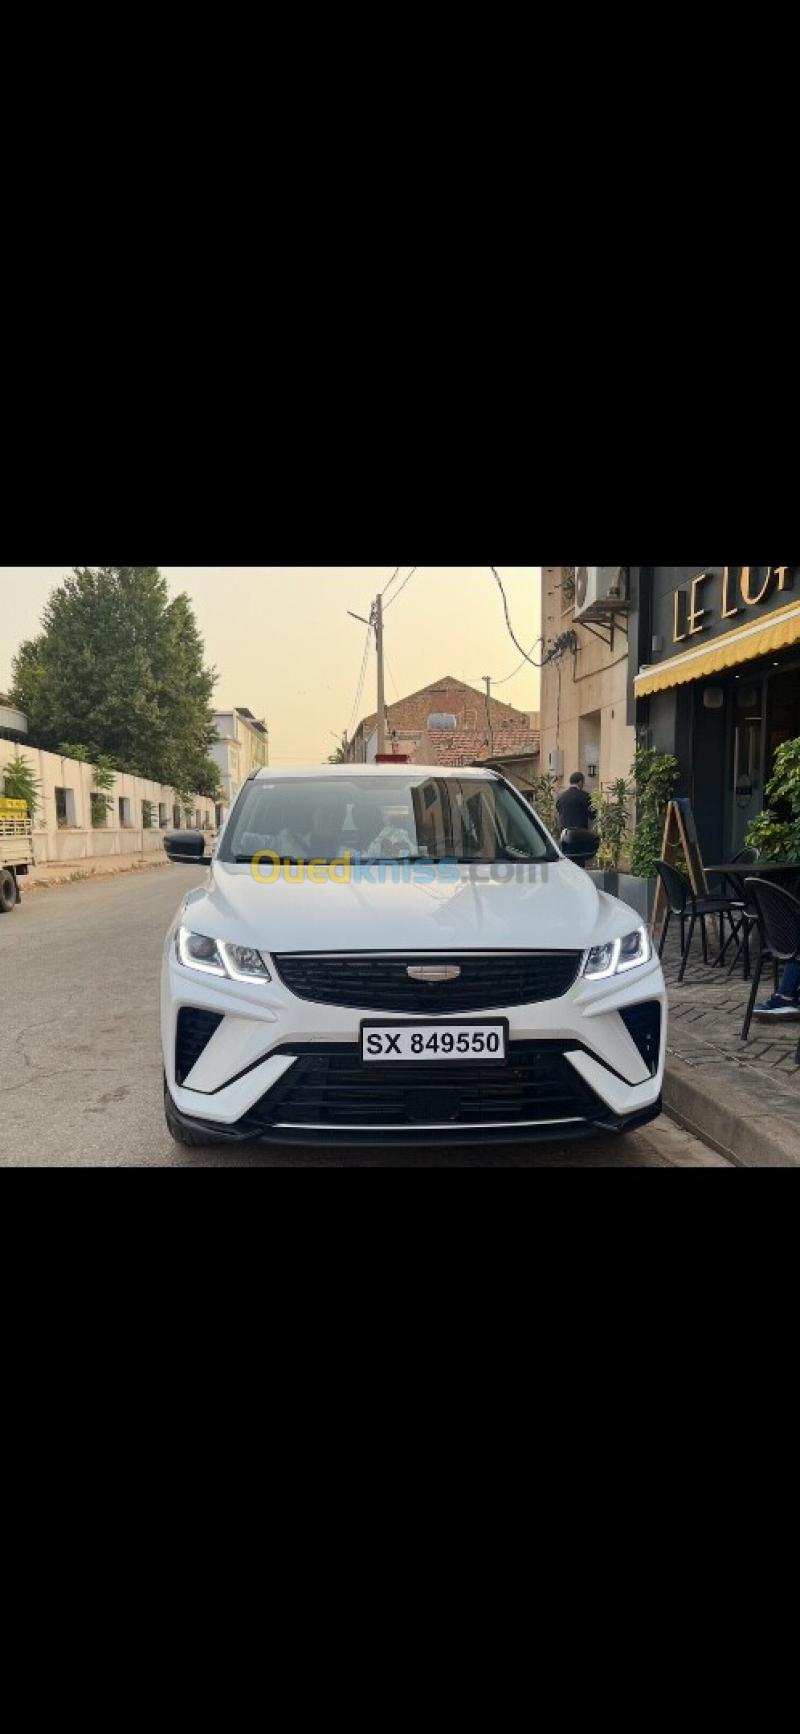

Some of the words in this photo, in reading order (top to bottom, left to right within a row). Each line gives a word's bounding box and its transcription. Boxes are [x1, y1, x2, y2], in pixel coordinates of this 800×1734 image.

[673, 574, 706, 642] LE
[367, 1033, 402, 1055] SX
[410, 1032, 499, 1054] 849550
